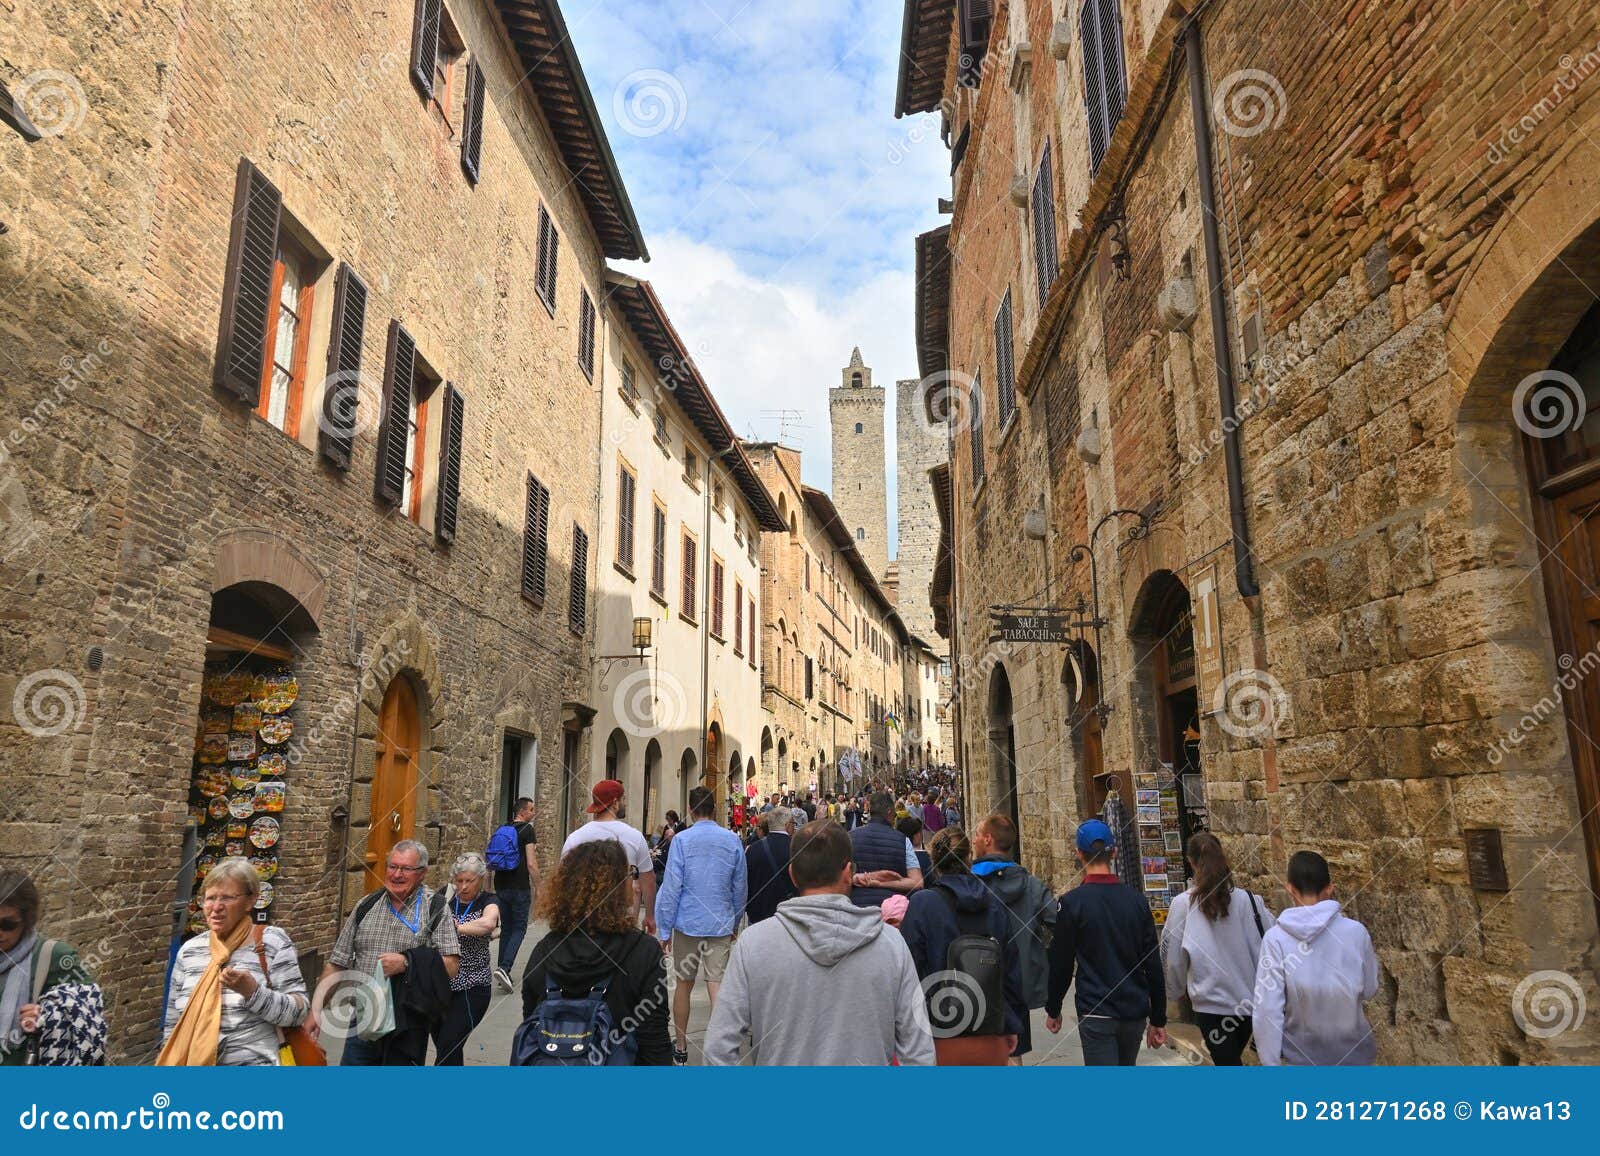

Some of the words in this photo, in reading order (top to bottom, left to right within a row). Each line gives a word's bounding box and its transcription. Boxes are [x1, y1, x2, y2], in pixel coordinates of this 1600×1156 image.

[1018, 617, 1039, 628] SALE
[1044, 620, 1049, 628] E
[1003, 629, 1049, 640] TABACCHI
